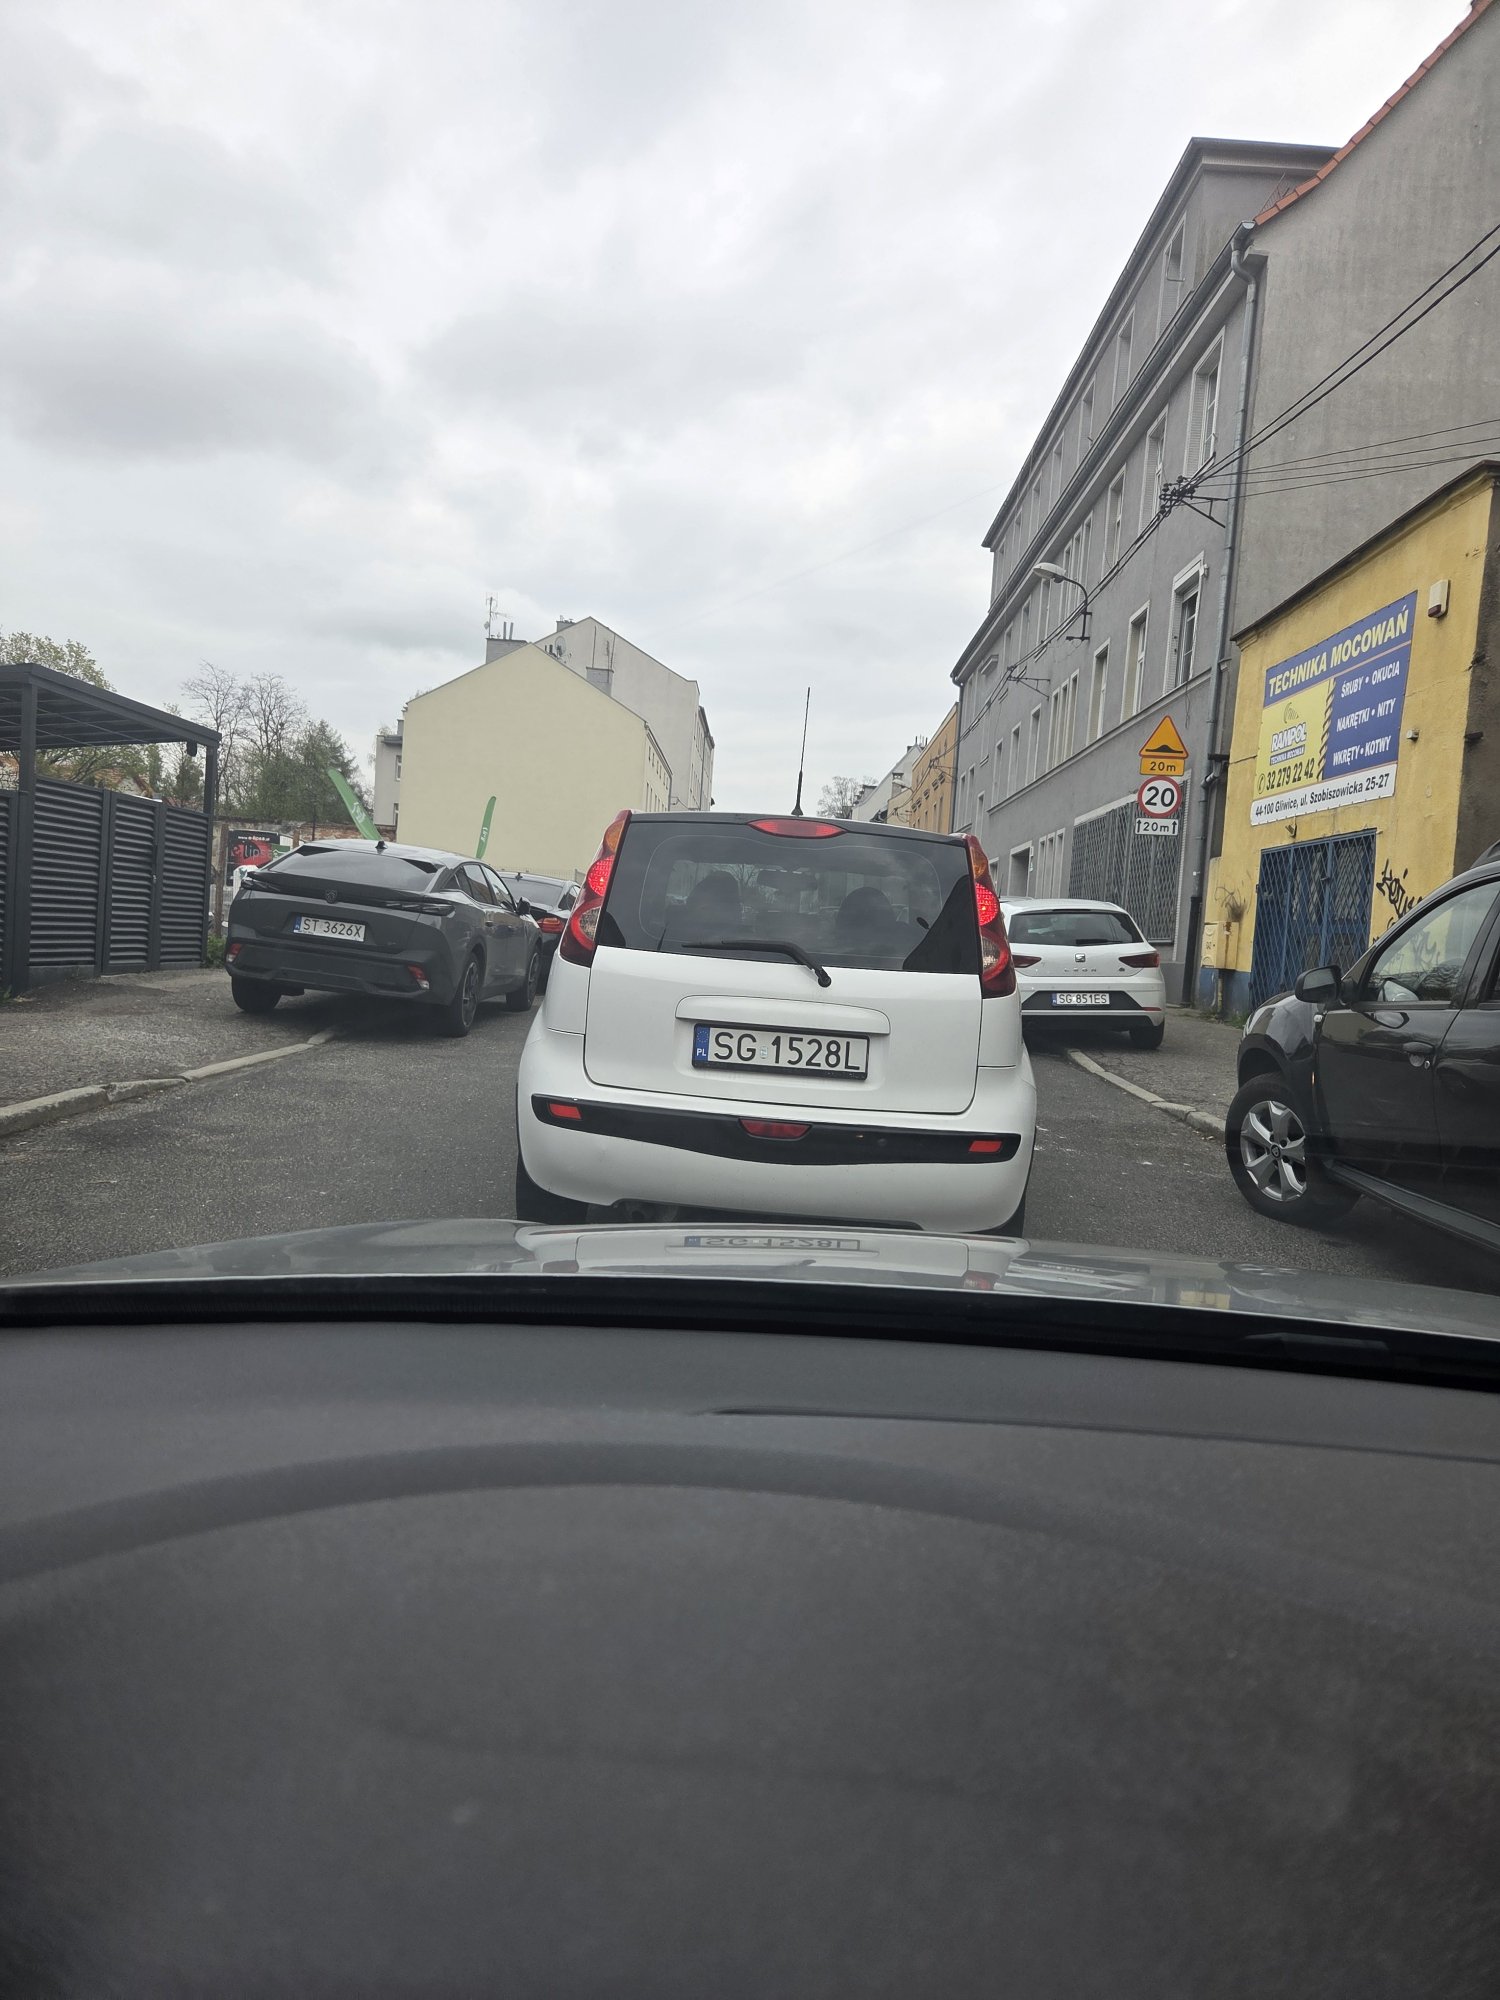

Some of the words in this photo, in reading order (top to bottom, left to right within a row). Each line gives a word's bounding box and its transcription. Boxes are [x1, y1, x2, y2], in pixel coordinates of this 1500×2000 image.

[1269, 652, 1327, 697] TECHNIKA
[1330, 605, 1409, 668] MOCOWAŃ
[1341, 676, 1364, 698] ŚRUBY
[1371, 660, 1400, 685] OKUCIA
[1336, 707, 1370, 732] NAKRĘTKI
[1377, 698, 1396, 718] NITY
[1271, 722, 1307, 753] RAMPOL
[1333, 745, 1361, 766] WKRĘTY
[1364, 736, 1392, 757] KOTWY
[1266, 770, 1276, 790] 32
[1276, 766, 1291, 787] 279
[1292, 762, 1303, 783] 22
[1304, 758, 1315, 779] 42
[1145, 786, 1175, 808] 20
[1255, 802, 1274, 816] 44-100
[1275, 799, 1299, 813] Gliwice,
[1300, 796, 1308, 807] ul.
[1310, 780, 1363, 804] Szobiszowicka
[1365, 773, 1390, 792] 25-27
[303, 918, 320, 932] ST
[323, 921, 362, 938] 3626X
[1058, 994, 1073, 1004] SG
[1075, 994, 1107, 1004] 851ES
[696, 1048, 707, 1057] PL
[714, 1031, 757, 1062] SG
[771, 1035, 861, 1071] 1528L
